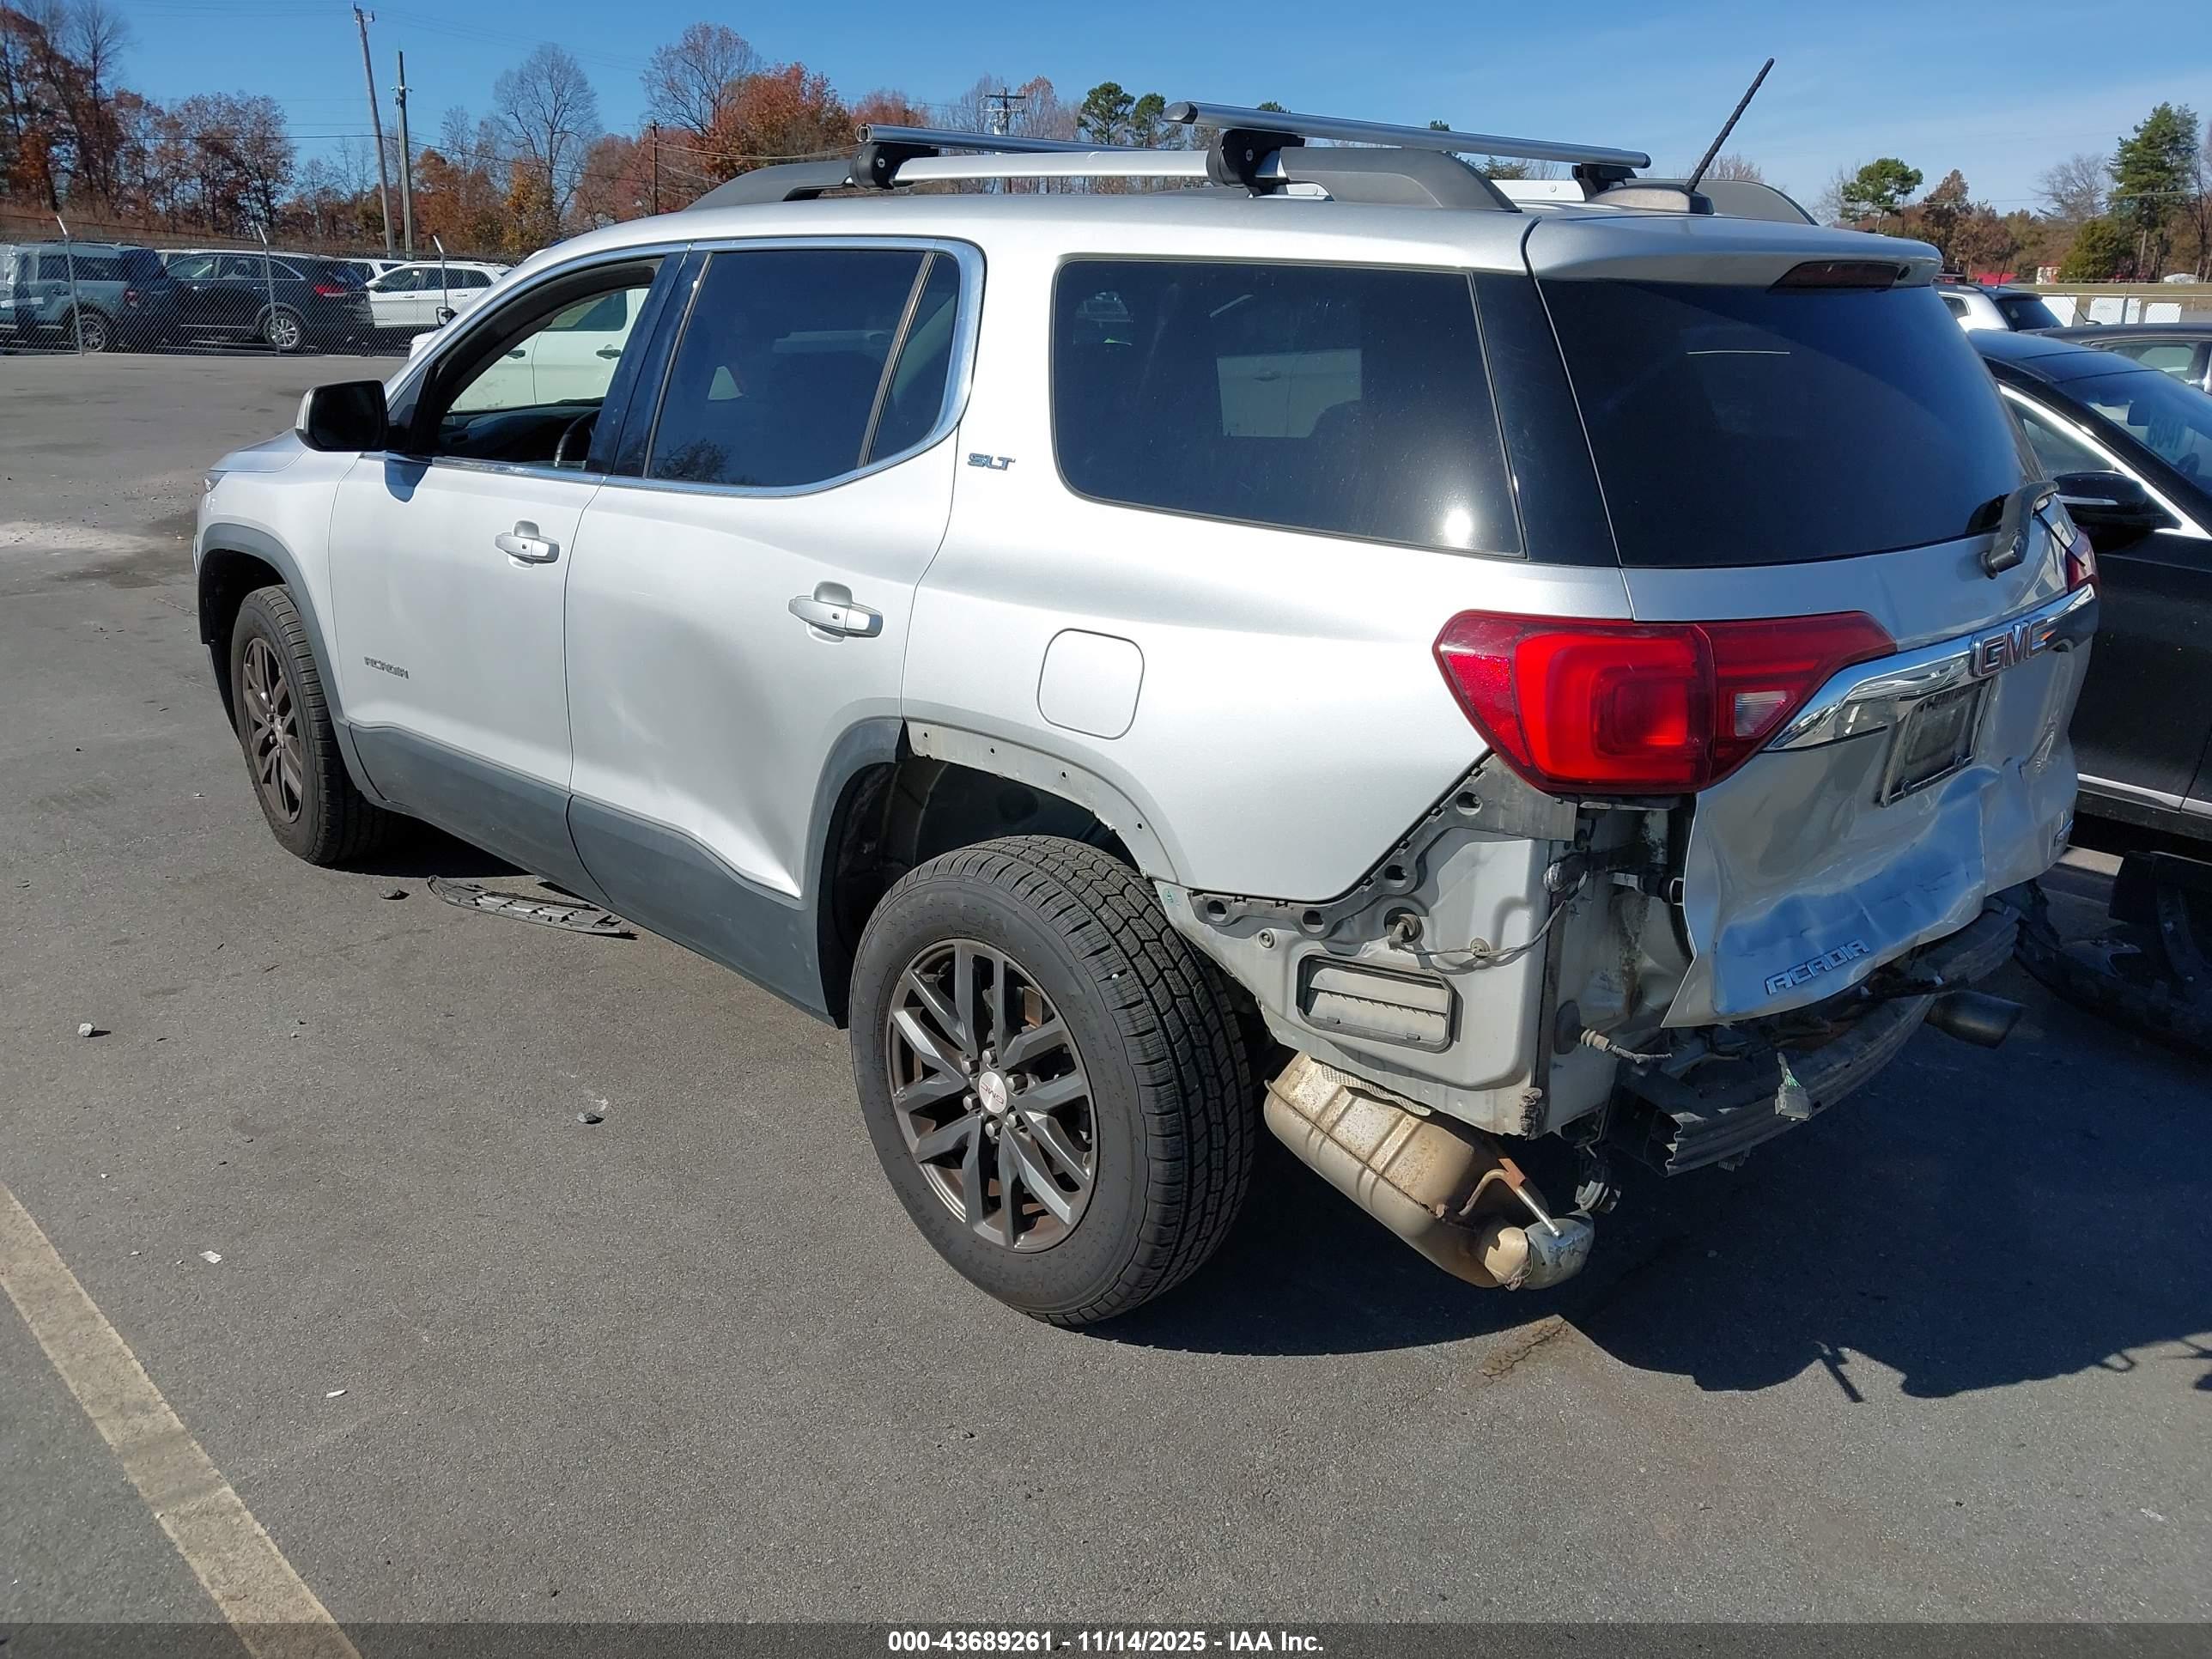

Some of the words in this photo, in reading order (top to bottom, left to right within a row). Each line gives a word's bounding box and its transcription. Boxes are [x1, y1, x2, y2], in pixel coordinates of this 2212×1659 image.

[967, 453, 1016, 471] SLT
[1973, 616, 2056, 677] GMC
[363, 656, 410, 679] ACADIA
[1765, 939, 1870, 995] ACADIA
[980, 1080, 1005, 1105] GMC
